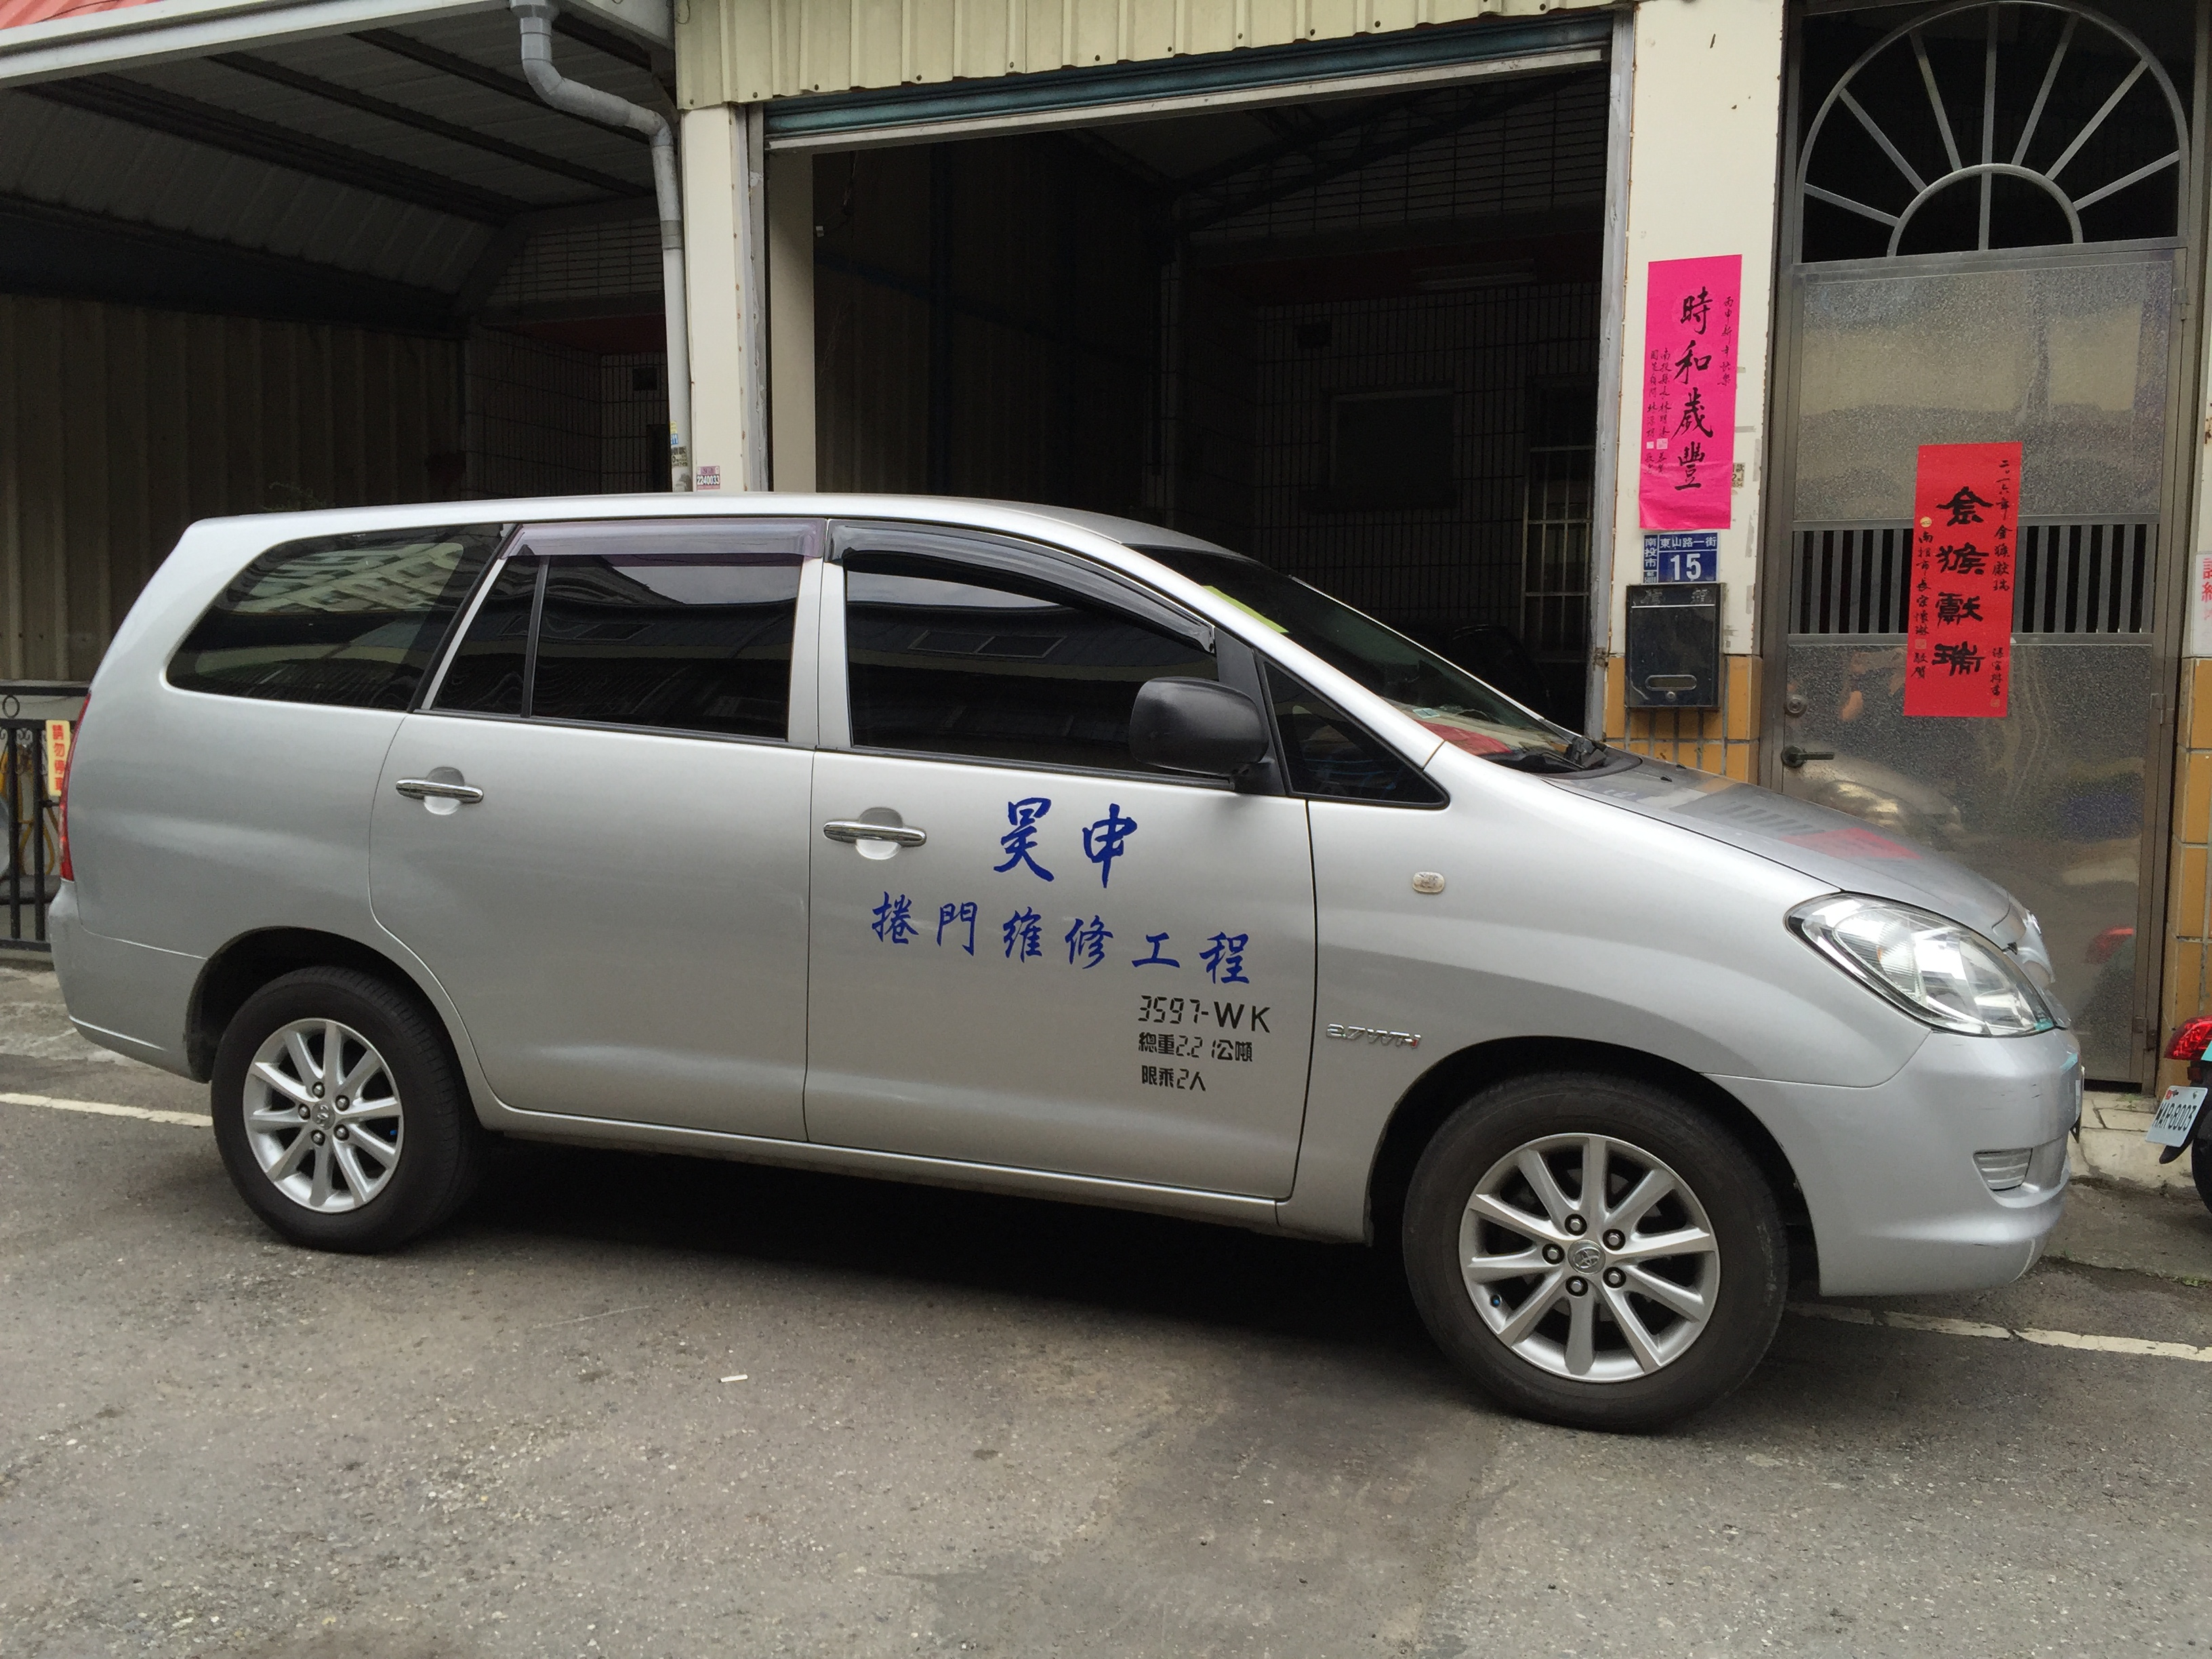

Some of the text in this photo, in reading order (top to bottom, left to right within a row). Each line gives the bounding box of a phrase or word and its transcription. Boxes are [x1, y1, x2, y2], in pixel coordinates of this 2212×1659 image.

[1670, 285, 1714, 491] 時和歲豐
[1644, 537, 1658, 568] 南投市
[1660, 536, 1717, 549] 東山路一街
[1670, 552, 1702, 581] 15
[1931, 485, 1994, 677] 金猴獻瑞
[872, 891, 1250, 985] 捲門維修工程
[1138, 994, 1271, 1033] 3597-WK
